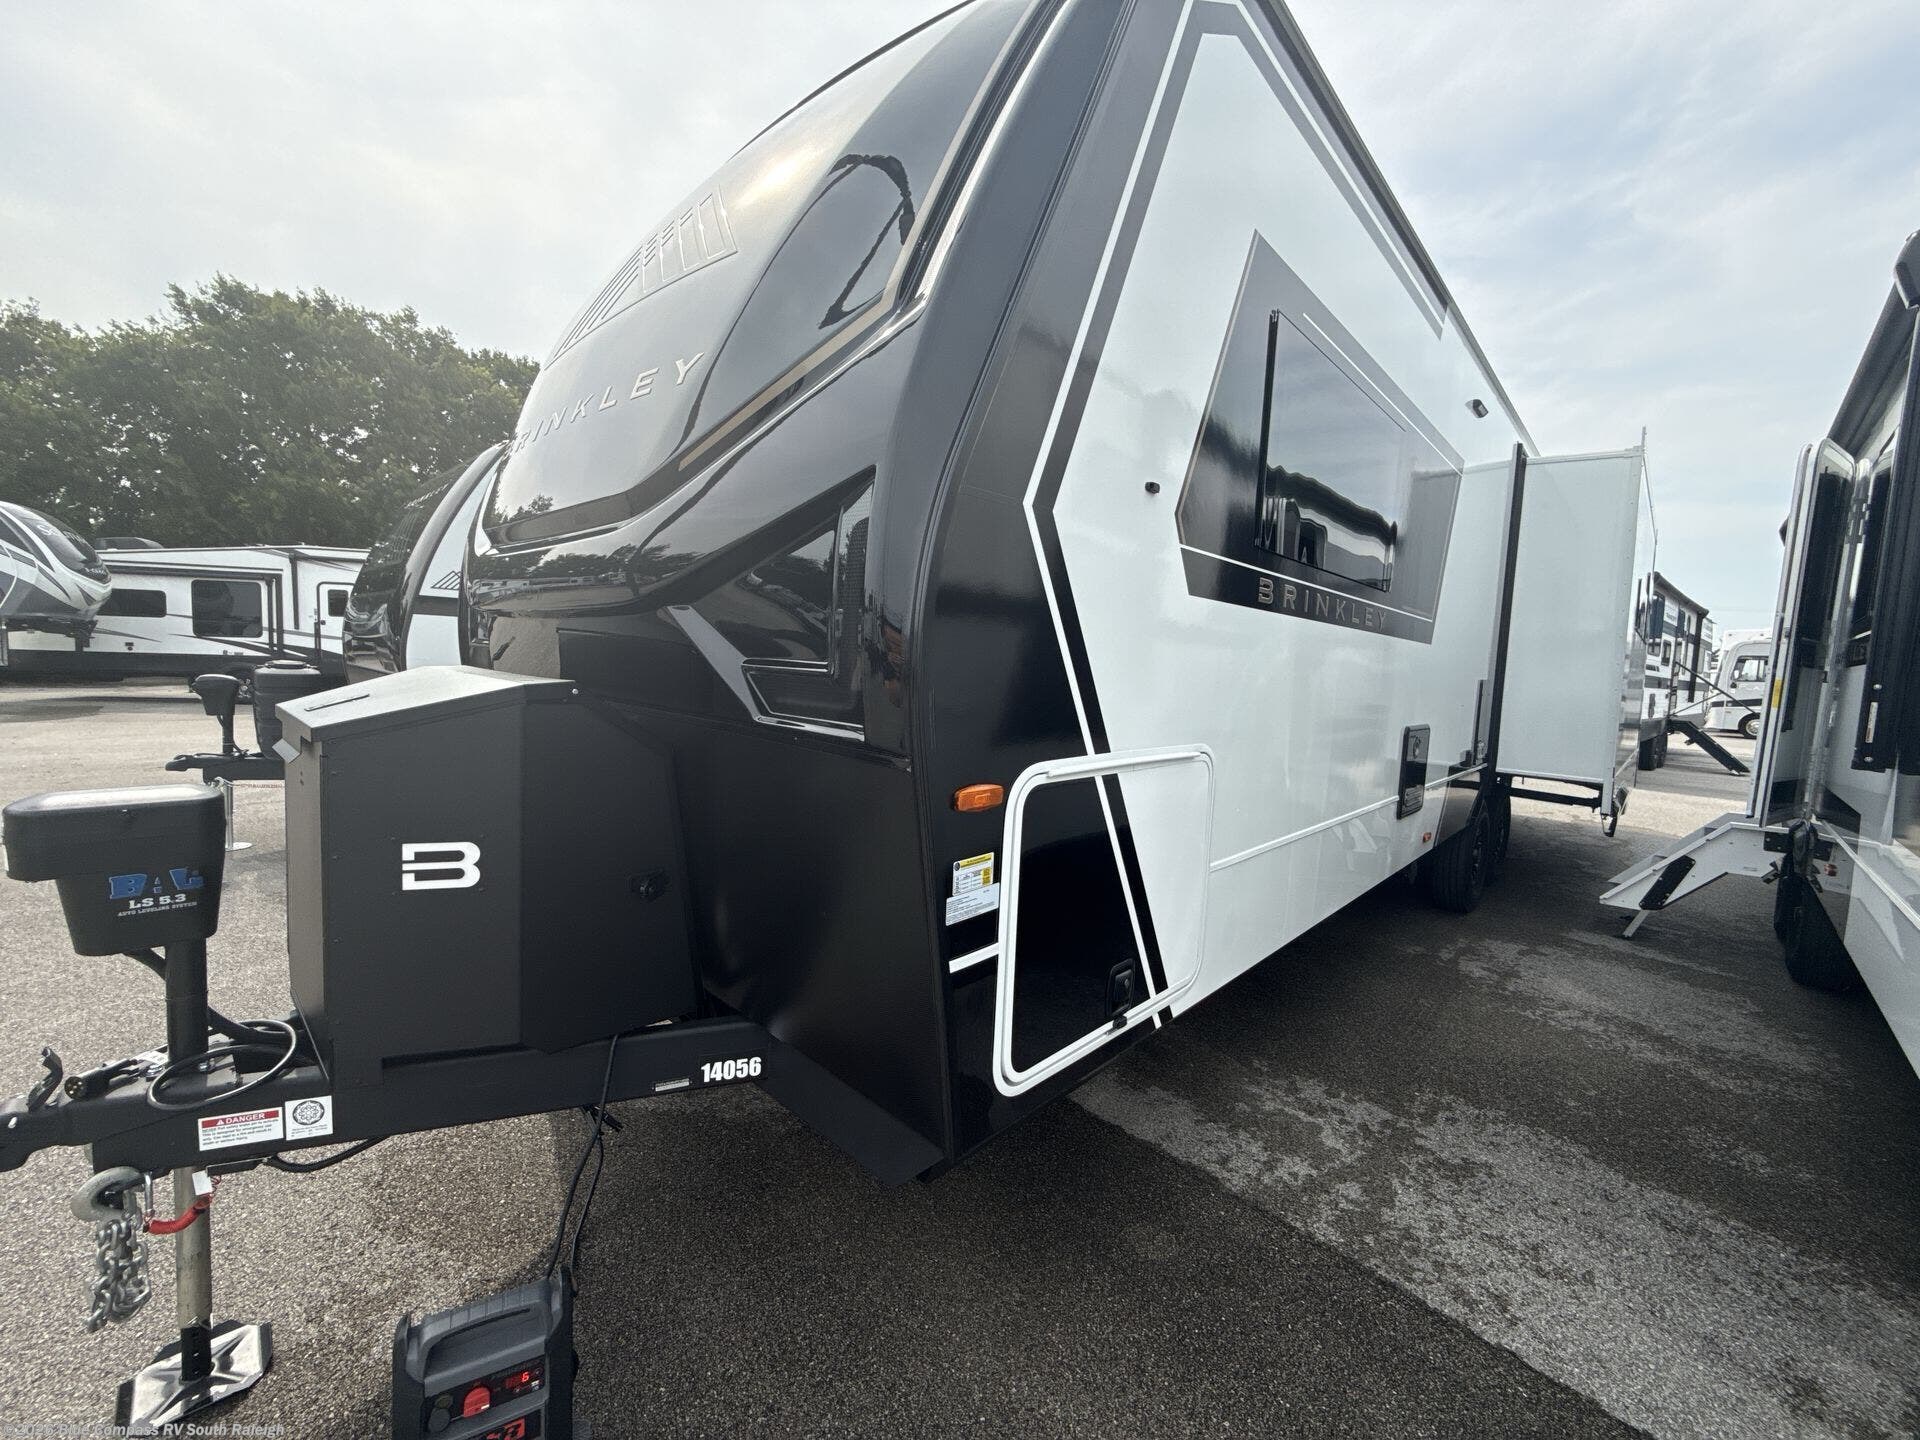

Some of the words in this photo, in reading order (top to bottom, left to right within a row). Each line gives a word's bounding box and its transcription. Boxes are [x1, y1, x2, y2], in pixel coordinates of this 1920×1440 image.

[510, 351, 705, 452] RINKLEY
[1258, 577, 1386, 632] BRINKLEY
[128, 898, 154, 909] LS
[700, 1056, 762, 1083] 14056
[225, 1112, 266, 1124] DANGER
